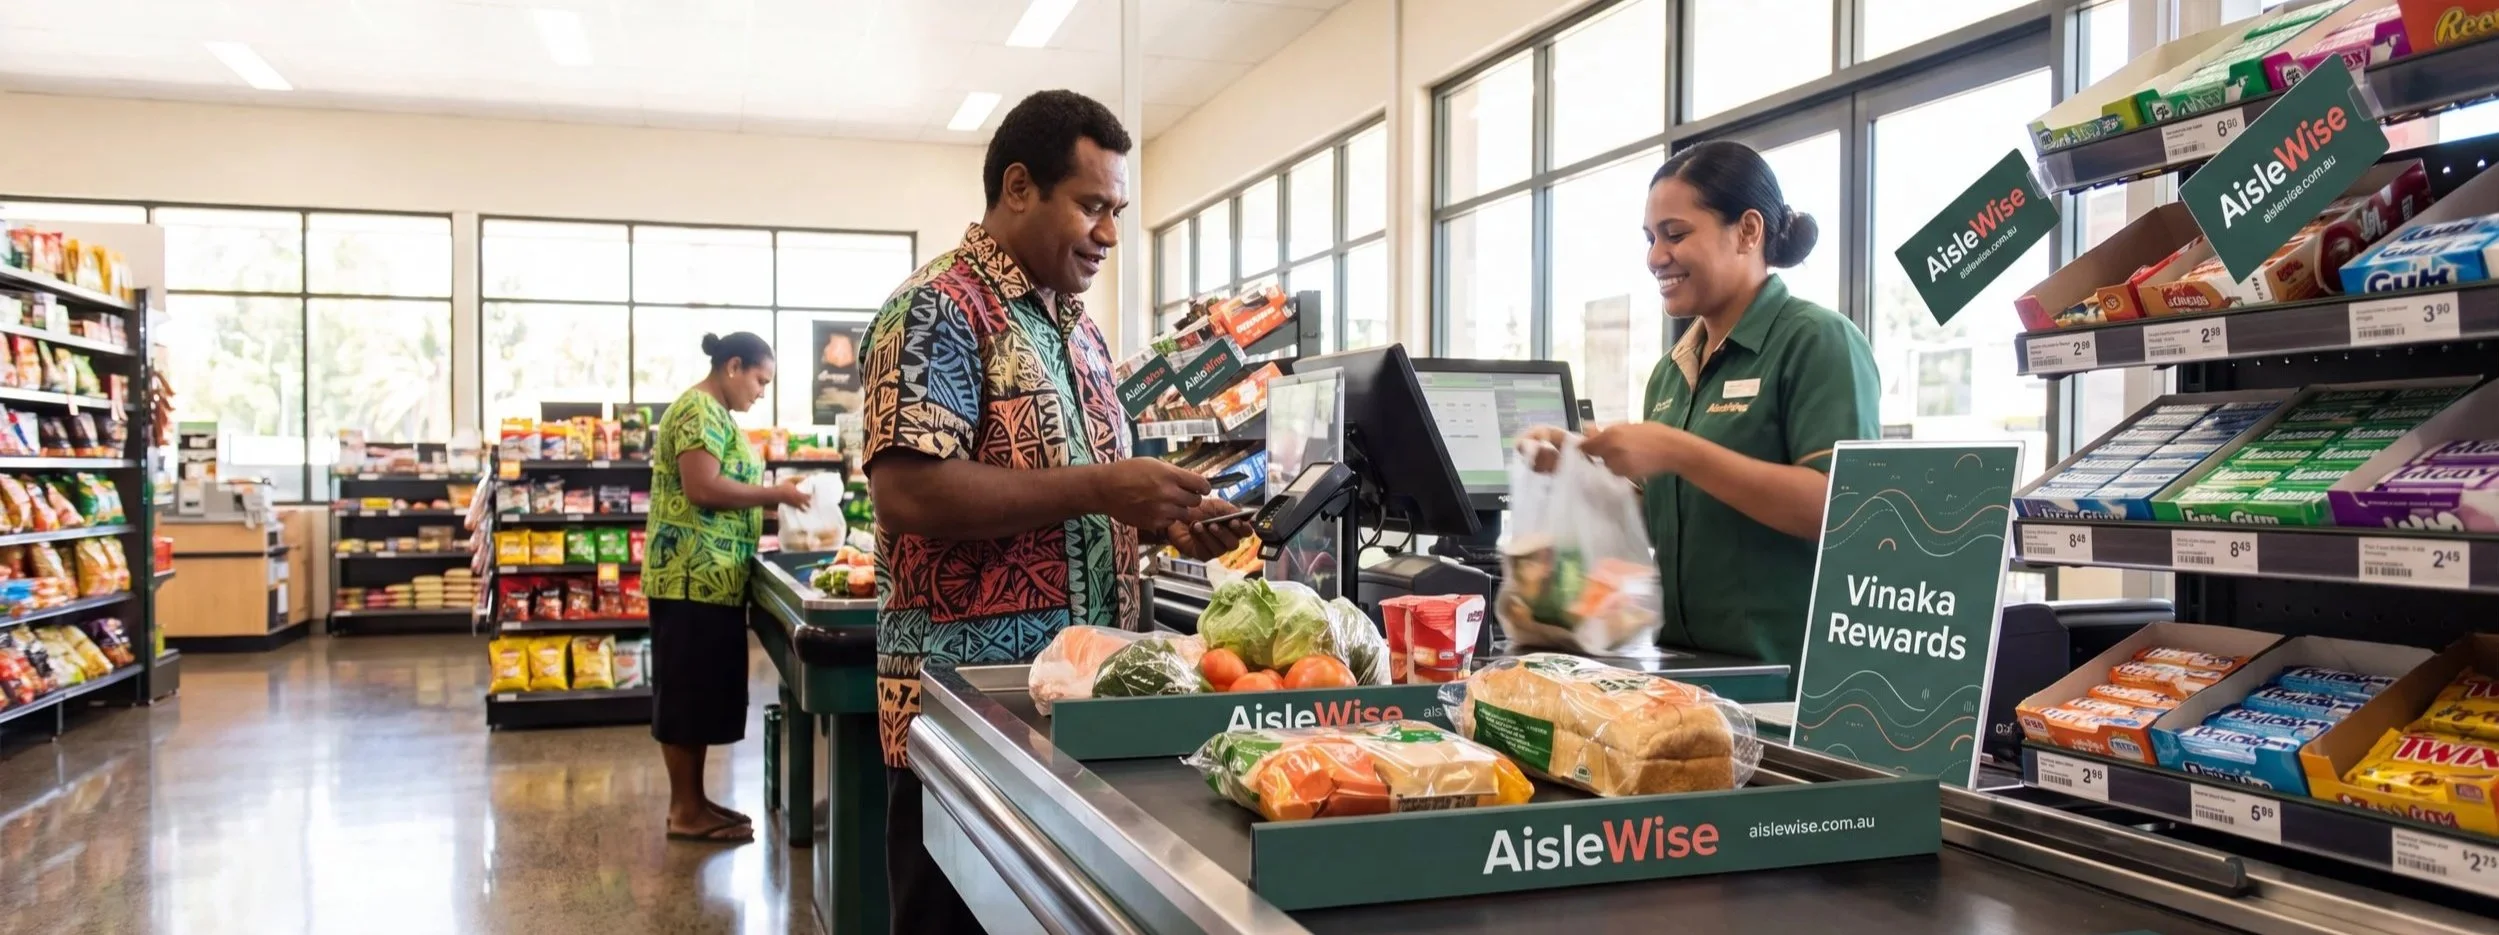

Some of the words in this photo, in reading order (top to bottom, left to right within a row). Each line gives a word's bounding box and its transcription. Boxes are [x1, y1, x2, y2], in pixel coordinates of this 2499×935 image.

[2219, 106, 2348, 229] AisleWise
[1926, 187, 2026, 283] AisleWise
[1847, 574, 1956, 616] Vinaka
[1827, 612, 1967, 661] Rewards
[1226, 698, 1404, 733] AisleWise
[2393, 734, 2499, 771] TWIX
[1482, 815, 1720, 876] AisleWise
[1748, 816, 1875, 838] aislewise.com.au
